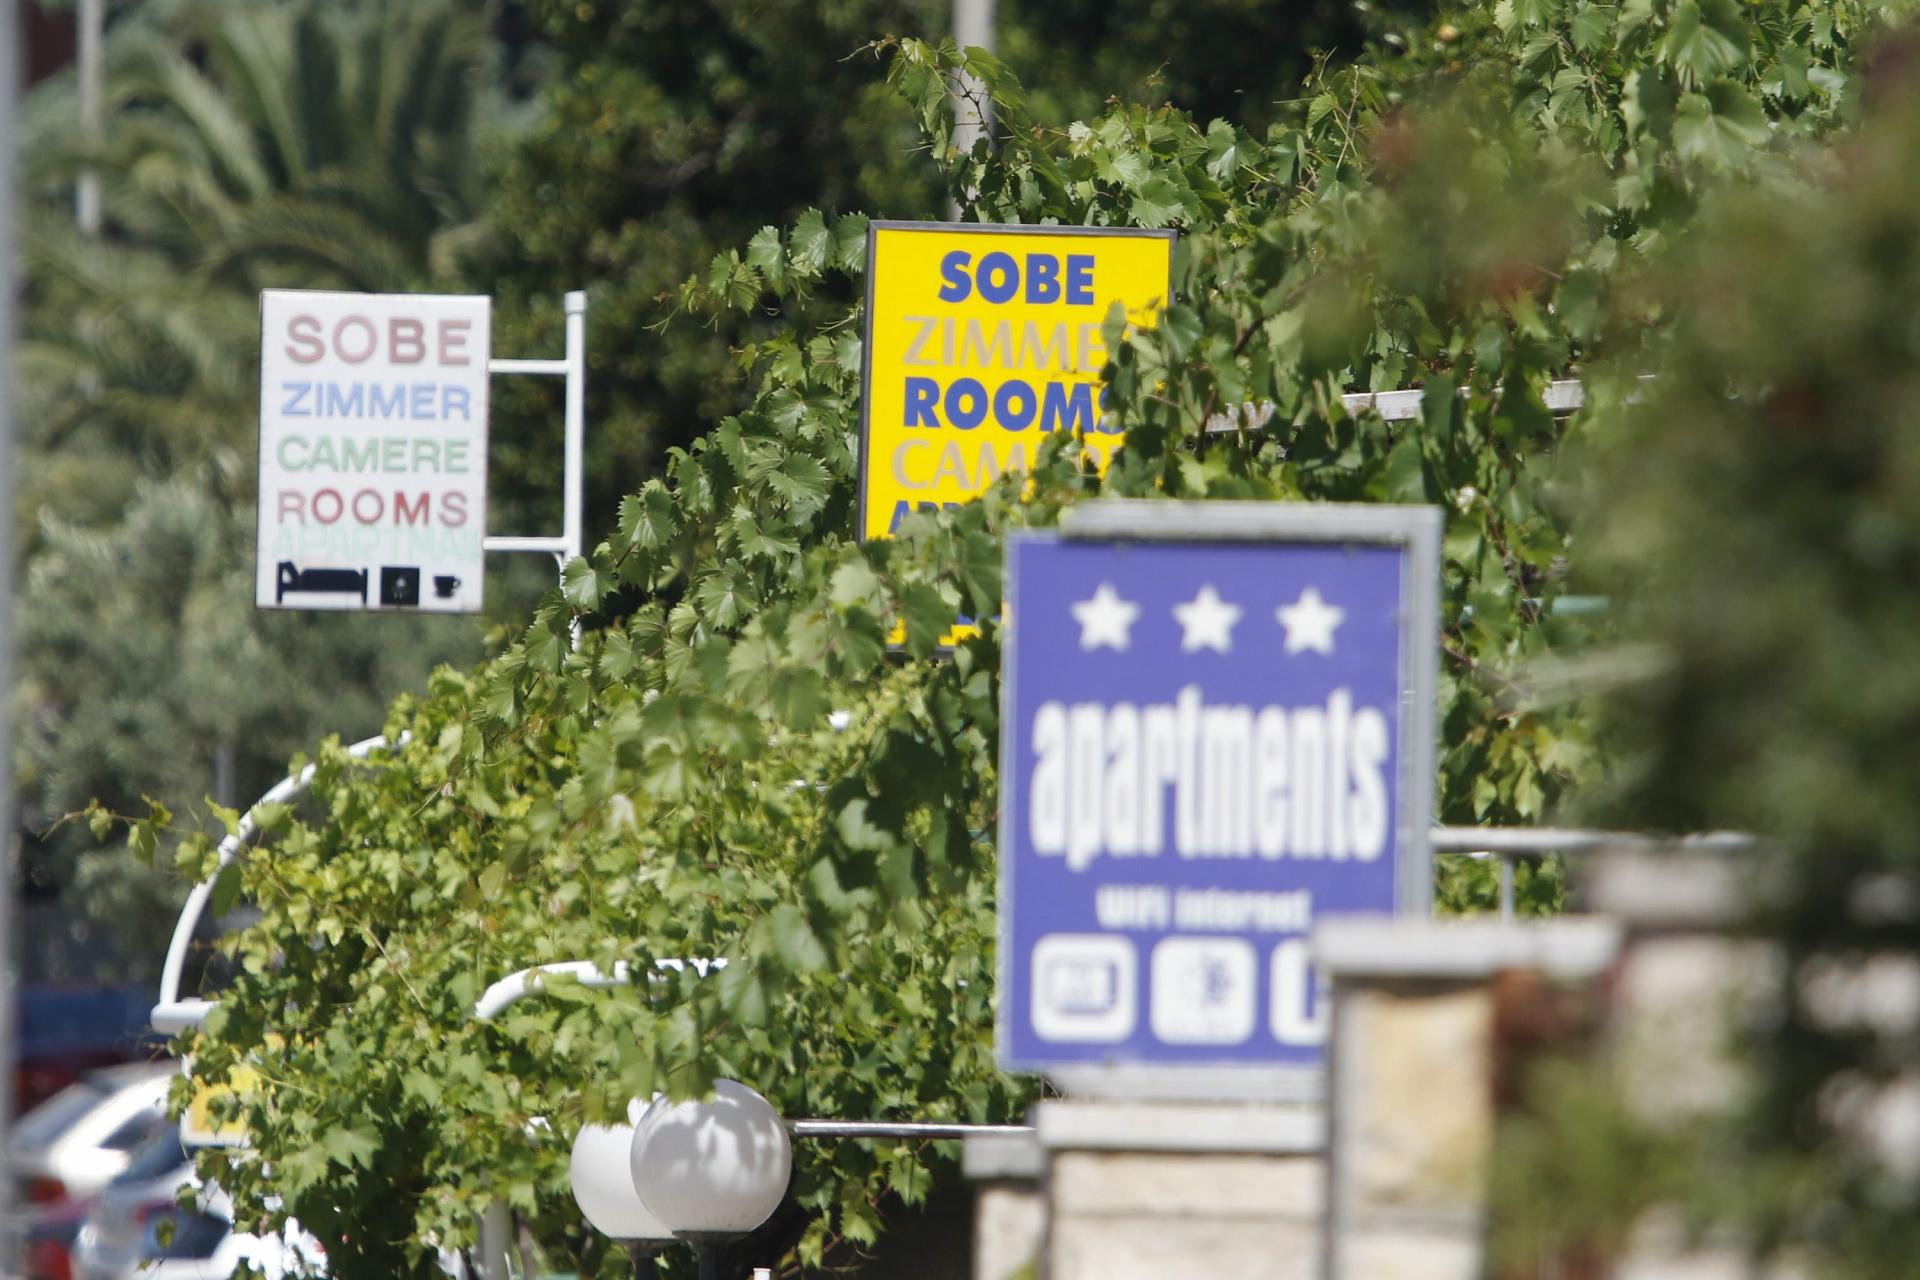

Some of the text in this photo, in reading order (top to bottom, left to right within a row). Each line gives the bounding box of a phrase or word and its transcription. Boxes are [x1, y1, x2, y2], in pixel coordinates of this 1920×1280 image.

[937, 250, 1095, 305] SOBE
[285, 313, 472, 366] SOBE
[902, 315, 1134, 373] ZIMME
[280, 381, 472, 420] ZIMMER
[276, 433, 470, 474] CAMERE
[276, 487, 469, 528] ROOMS
[1029, 683, 1390, 872] apartments
